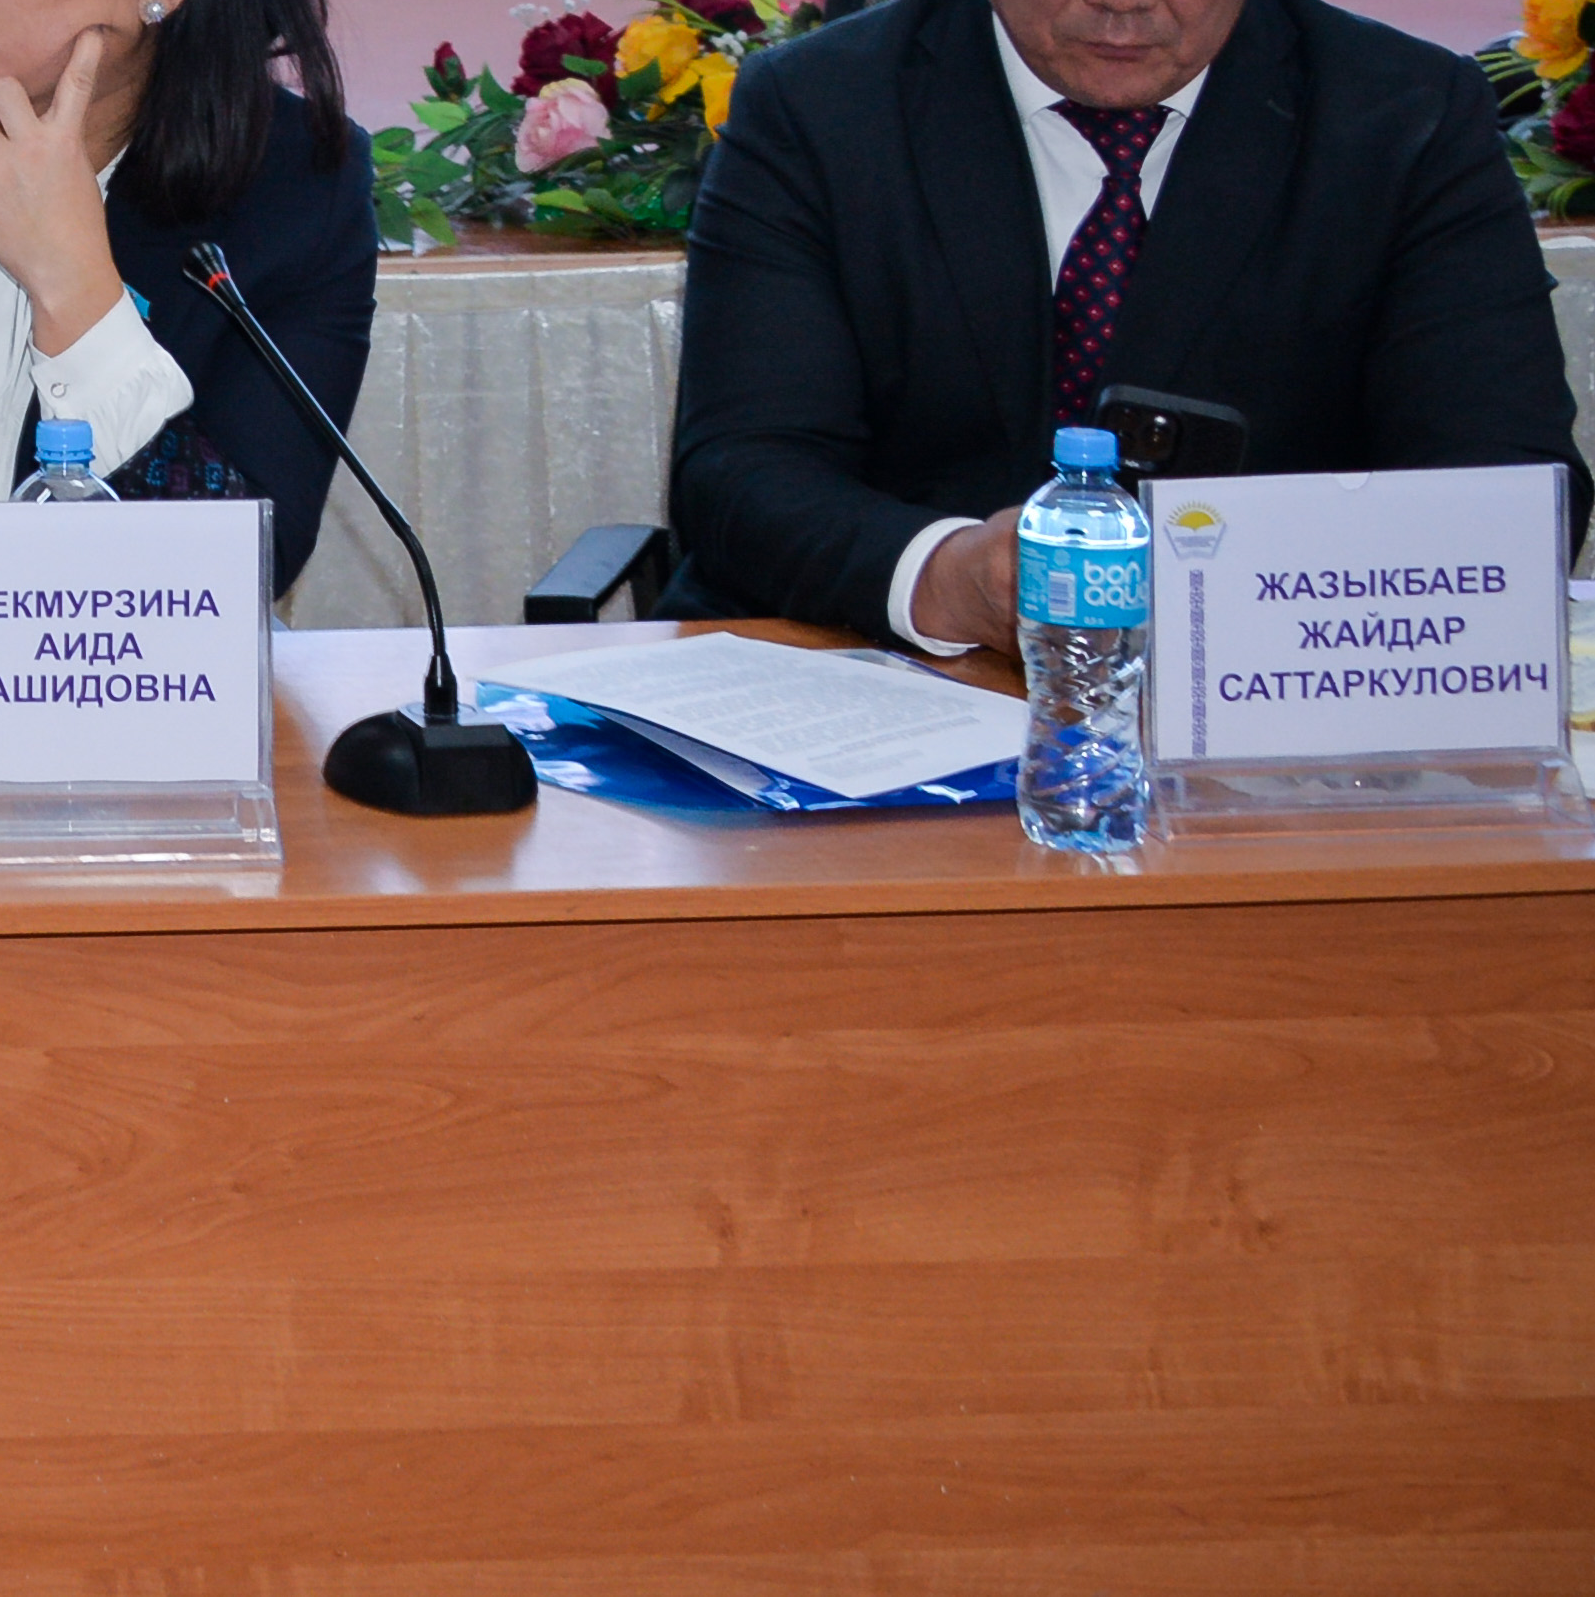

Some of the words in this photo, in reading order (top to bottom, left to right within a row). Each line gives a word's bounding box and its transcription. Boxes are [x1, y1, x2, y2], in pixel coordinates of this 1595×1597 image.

[1083, 559, 1141, 585] bon
[1255, 565, 1506, 602] ЖАЗЫКБАЕВ
[34, 632, 143, 666] АИДА
[1298, 612, 1466, 653] ЖАЙДАР
[1218, 663, 1548, 702] САТТАРКУЛОВИЧ
